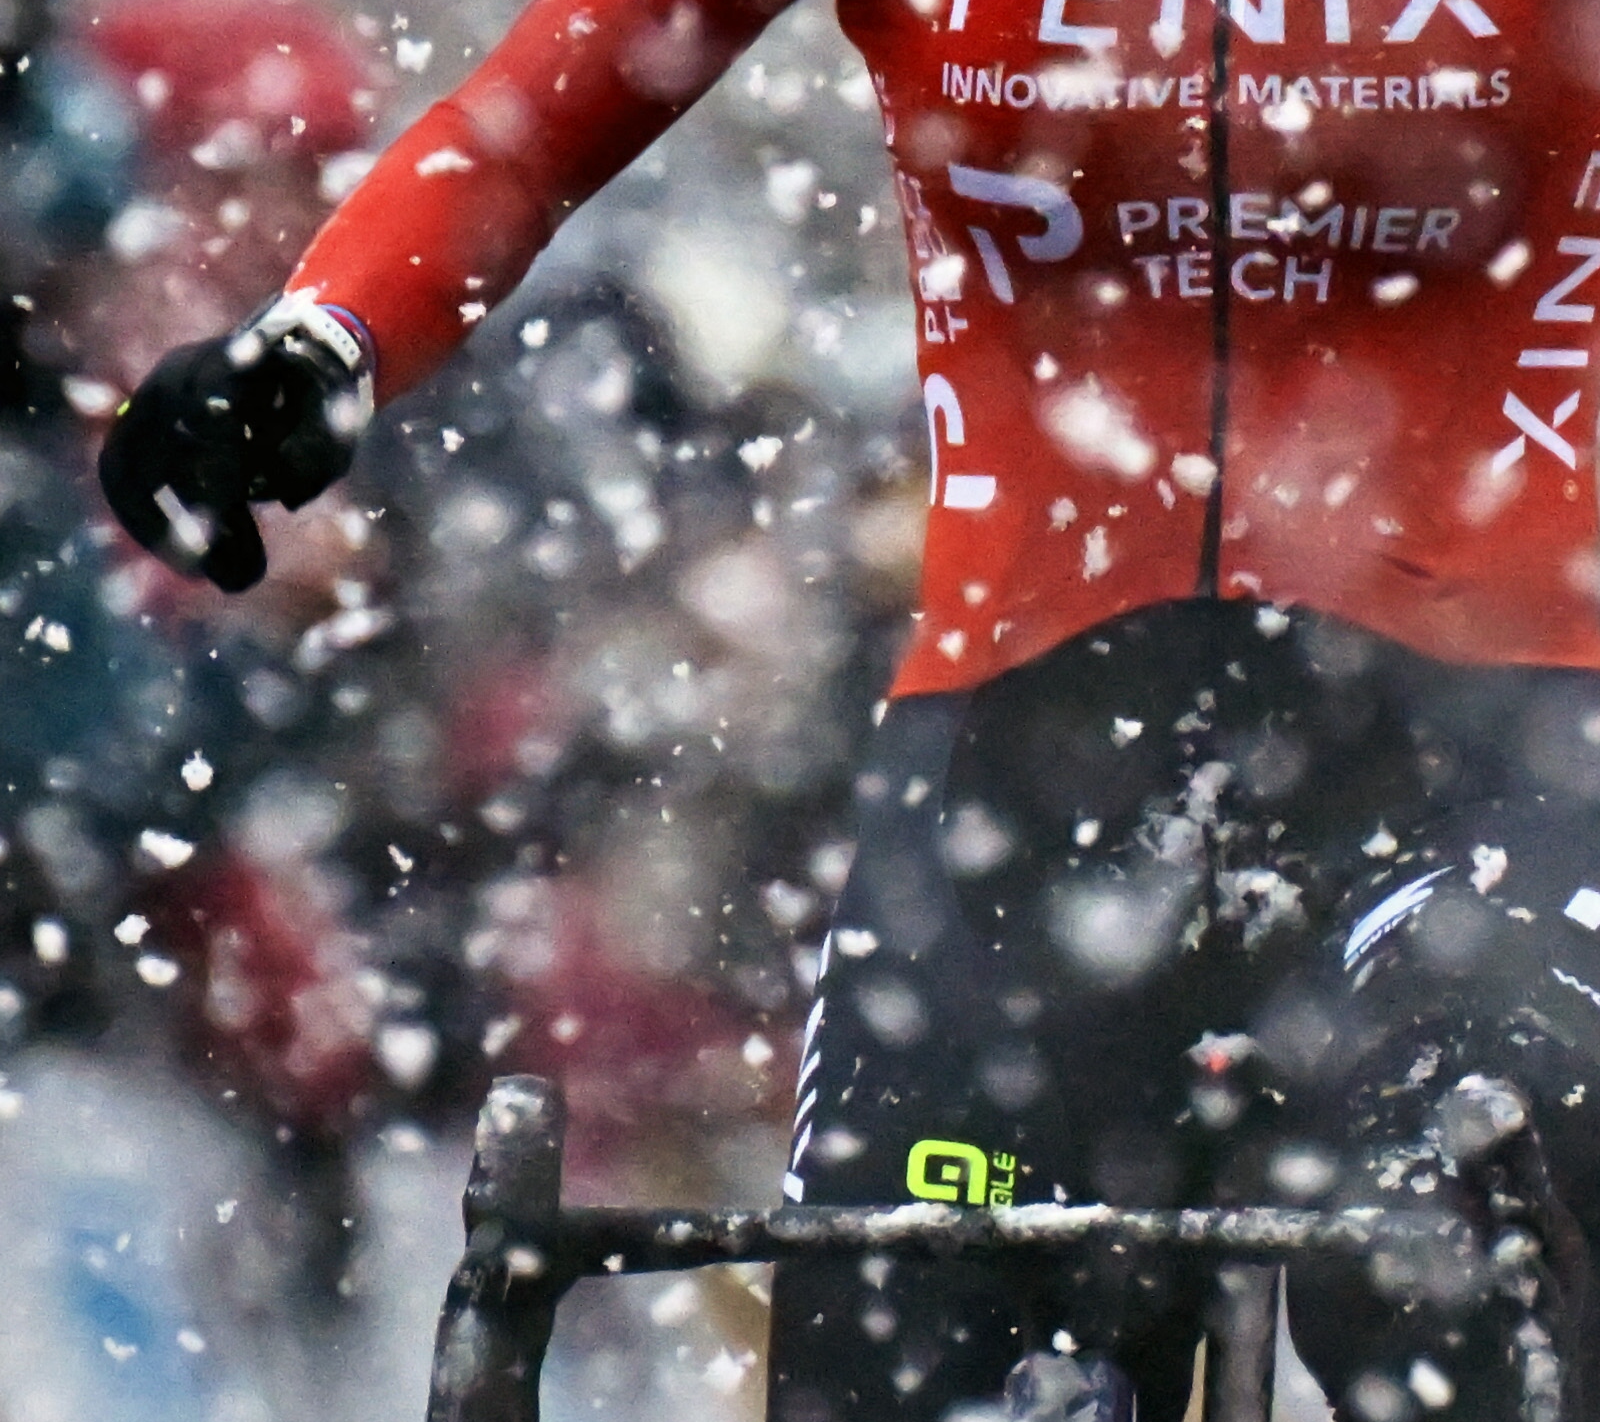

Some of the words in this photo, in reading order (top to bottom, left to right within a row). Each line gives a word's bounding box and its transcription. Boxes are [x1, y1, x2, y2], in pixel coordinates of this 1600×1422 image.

[941, 61, 1204, 111] INNOVIVE
[1116, 192, 1462, 252] PREMIER
[1134, 250, 1333, 303] TECH
